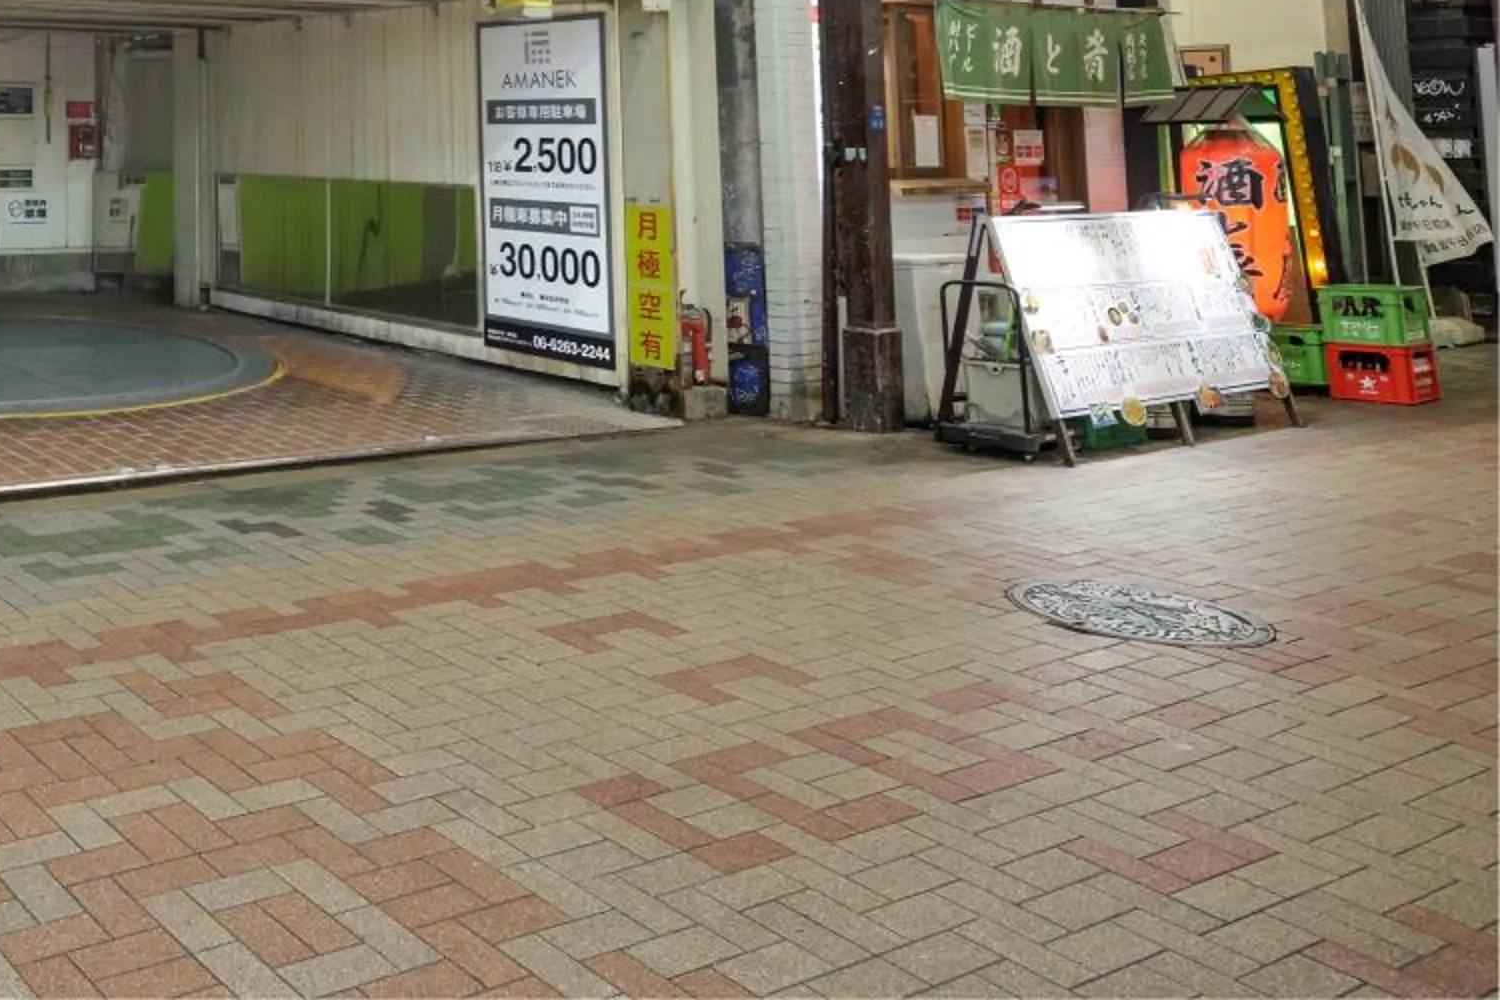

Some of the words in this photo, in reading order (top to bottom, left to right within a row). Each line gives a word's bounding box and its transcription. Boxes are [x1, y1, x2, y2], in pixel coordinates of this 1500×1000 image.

[502, 69, 578, 89] AMANEK
[636, 211, 662, 361] 月極空有
